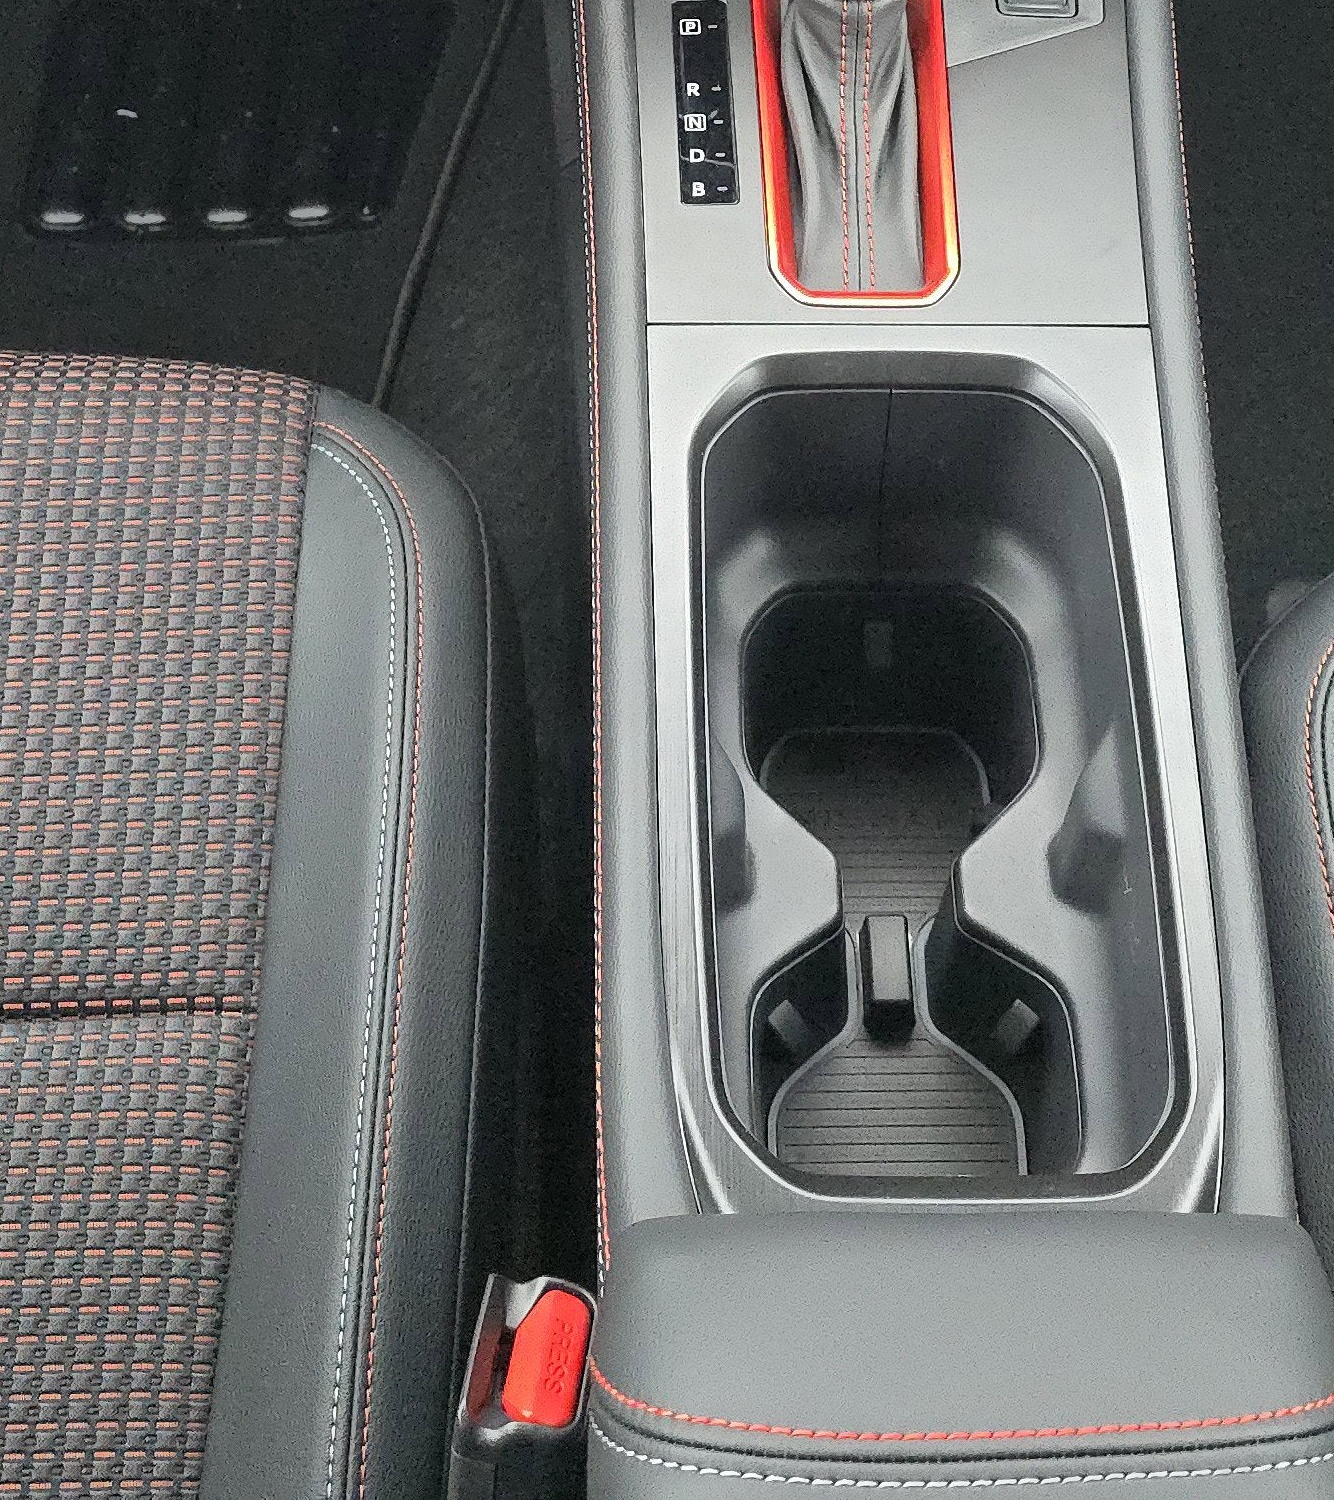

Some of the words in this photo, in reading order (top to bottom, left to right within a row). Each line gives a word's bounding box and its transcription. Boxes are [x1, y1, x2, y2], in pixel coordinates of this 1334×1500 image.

[684, 21, 697, 34] P
[686, 82, 701, 97] R
[688, 116, 702, 130] N
[689, 148, 706, 163] D
[691, 181, 706, 197] B
